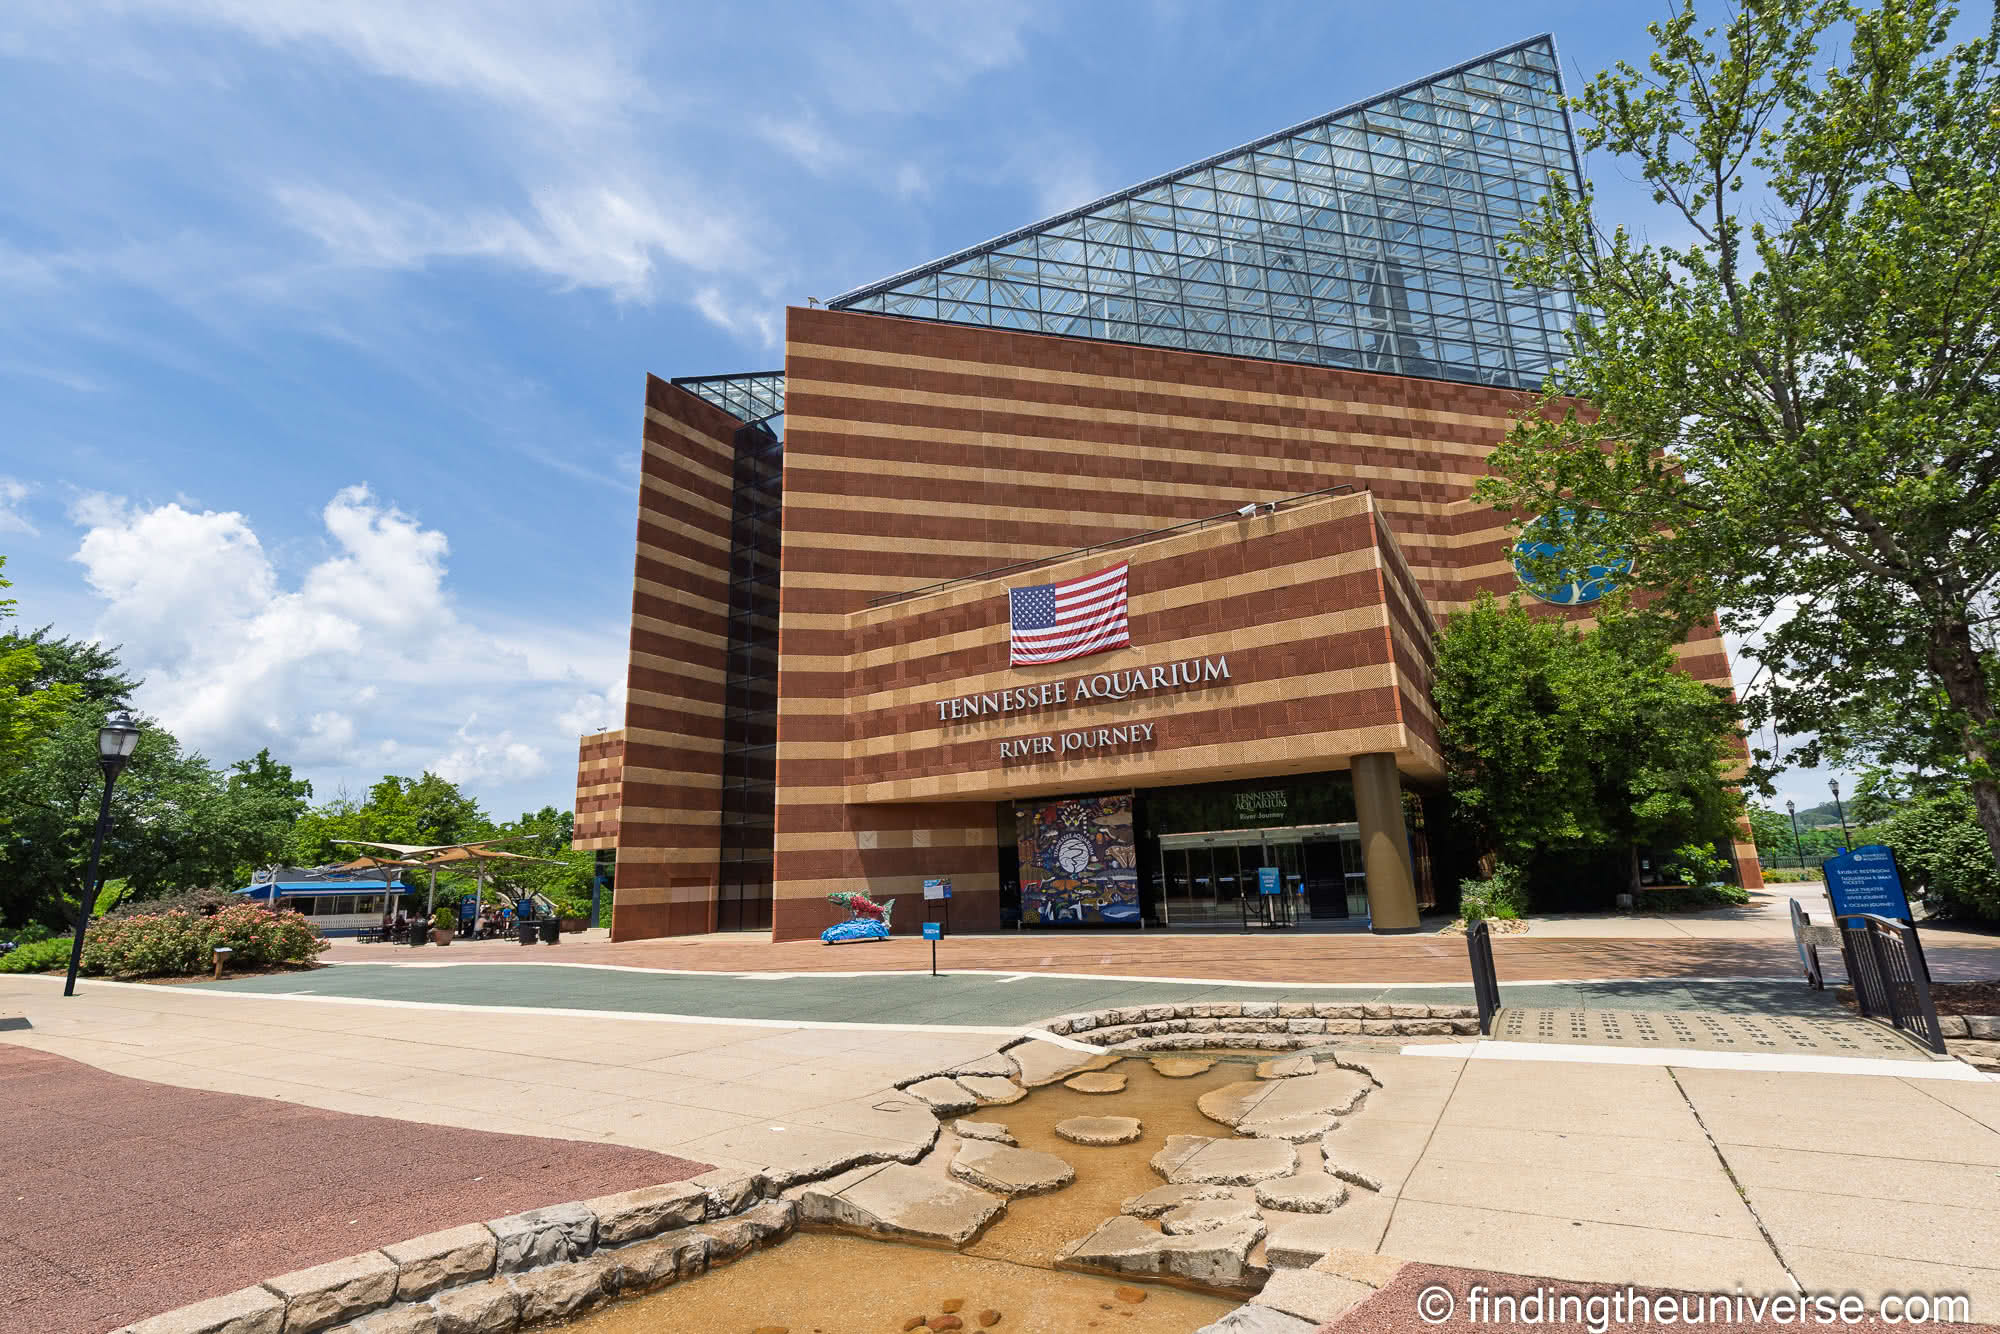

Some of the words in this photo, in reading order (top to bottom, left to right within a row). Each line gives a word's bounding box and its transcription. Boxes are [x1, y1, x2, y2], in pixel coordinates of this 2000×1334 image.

[936, 682, 1067, 721] TENNESSEE
[1074, 655, 1232, 701] AQUARIUM
[1000, 736, 1056, 759] RIVER
[1060, 723, 1154, 755] JOURNEY
[1235, 791, 1286, 801] TENNESSEE
[1235, 799, 1287, 811] AQUARIUM
[1257, 811, 1285, 819] Journey
